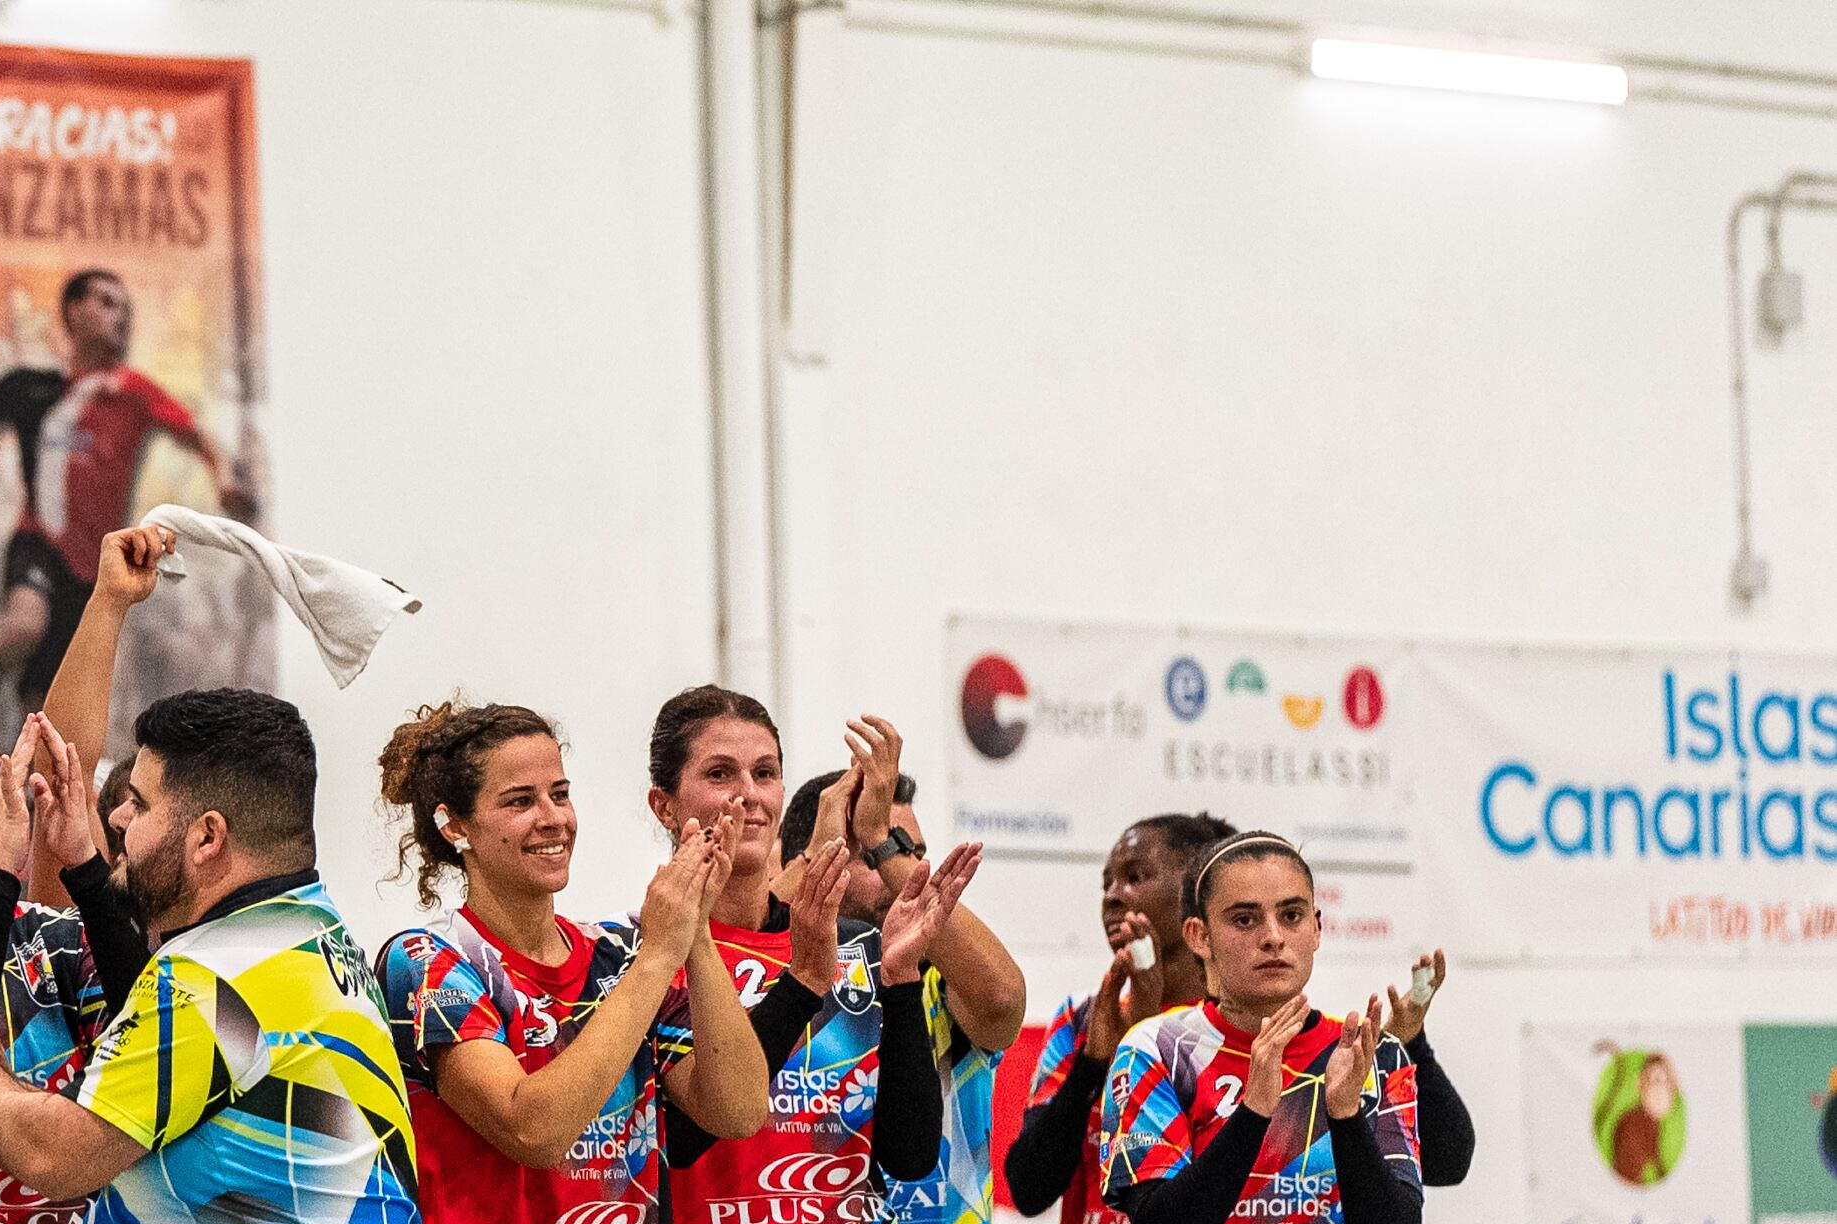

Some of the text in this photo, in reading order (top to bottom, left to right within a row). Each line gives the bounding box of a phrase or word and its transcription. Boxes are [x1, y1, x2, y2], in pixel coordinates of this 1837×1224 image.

[1662, 670, 1837, 763] Islas
[1478, 760, 1837, 860] Canarias
[768, 1091, 843, 1114] arias
[566, 1137, 626, 1160] arias
[1274, 1172, 1332, 1194] Islas
[1229, 1194, 1331, 1217] anarias
